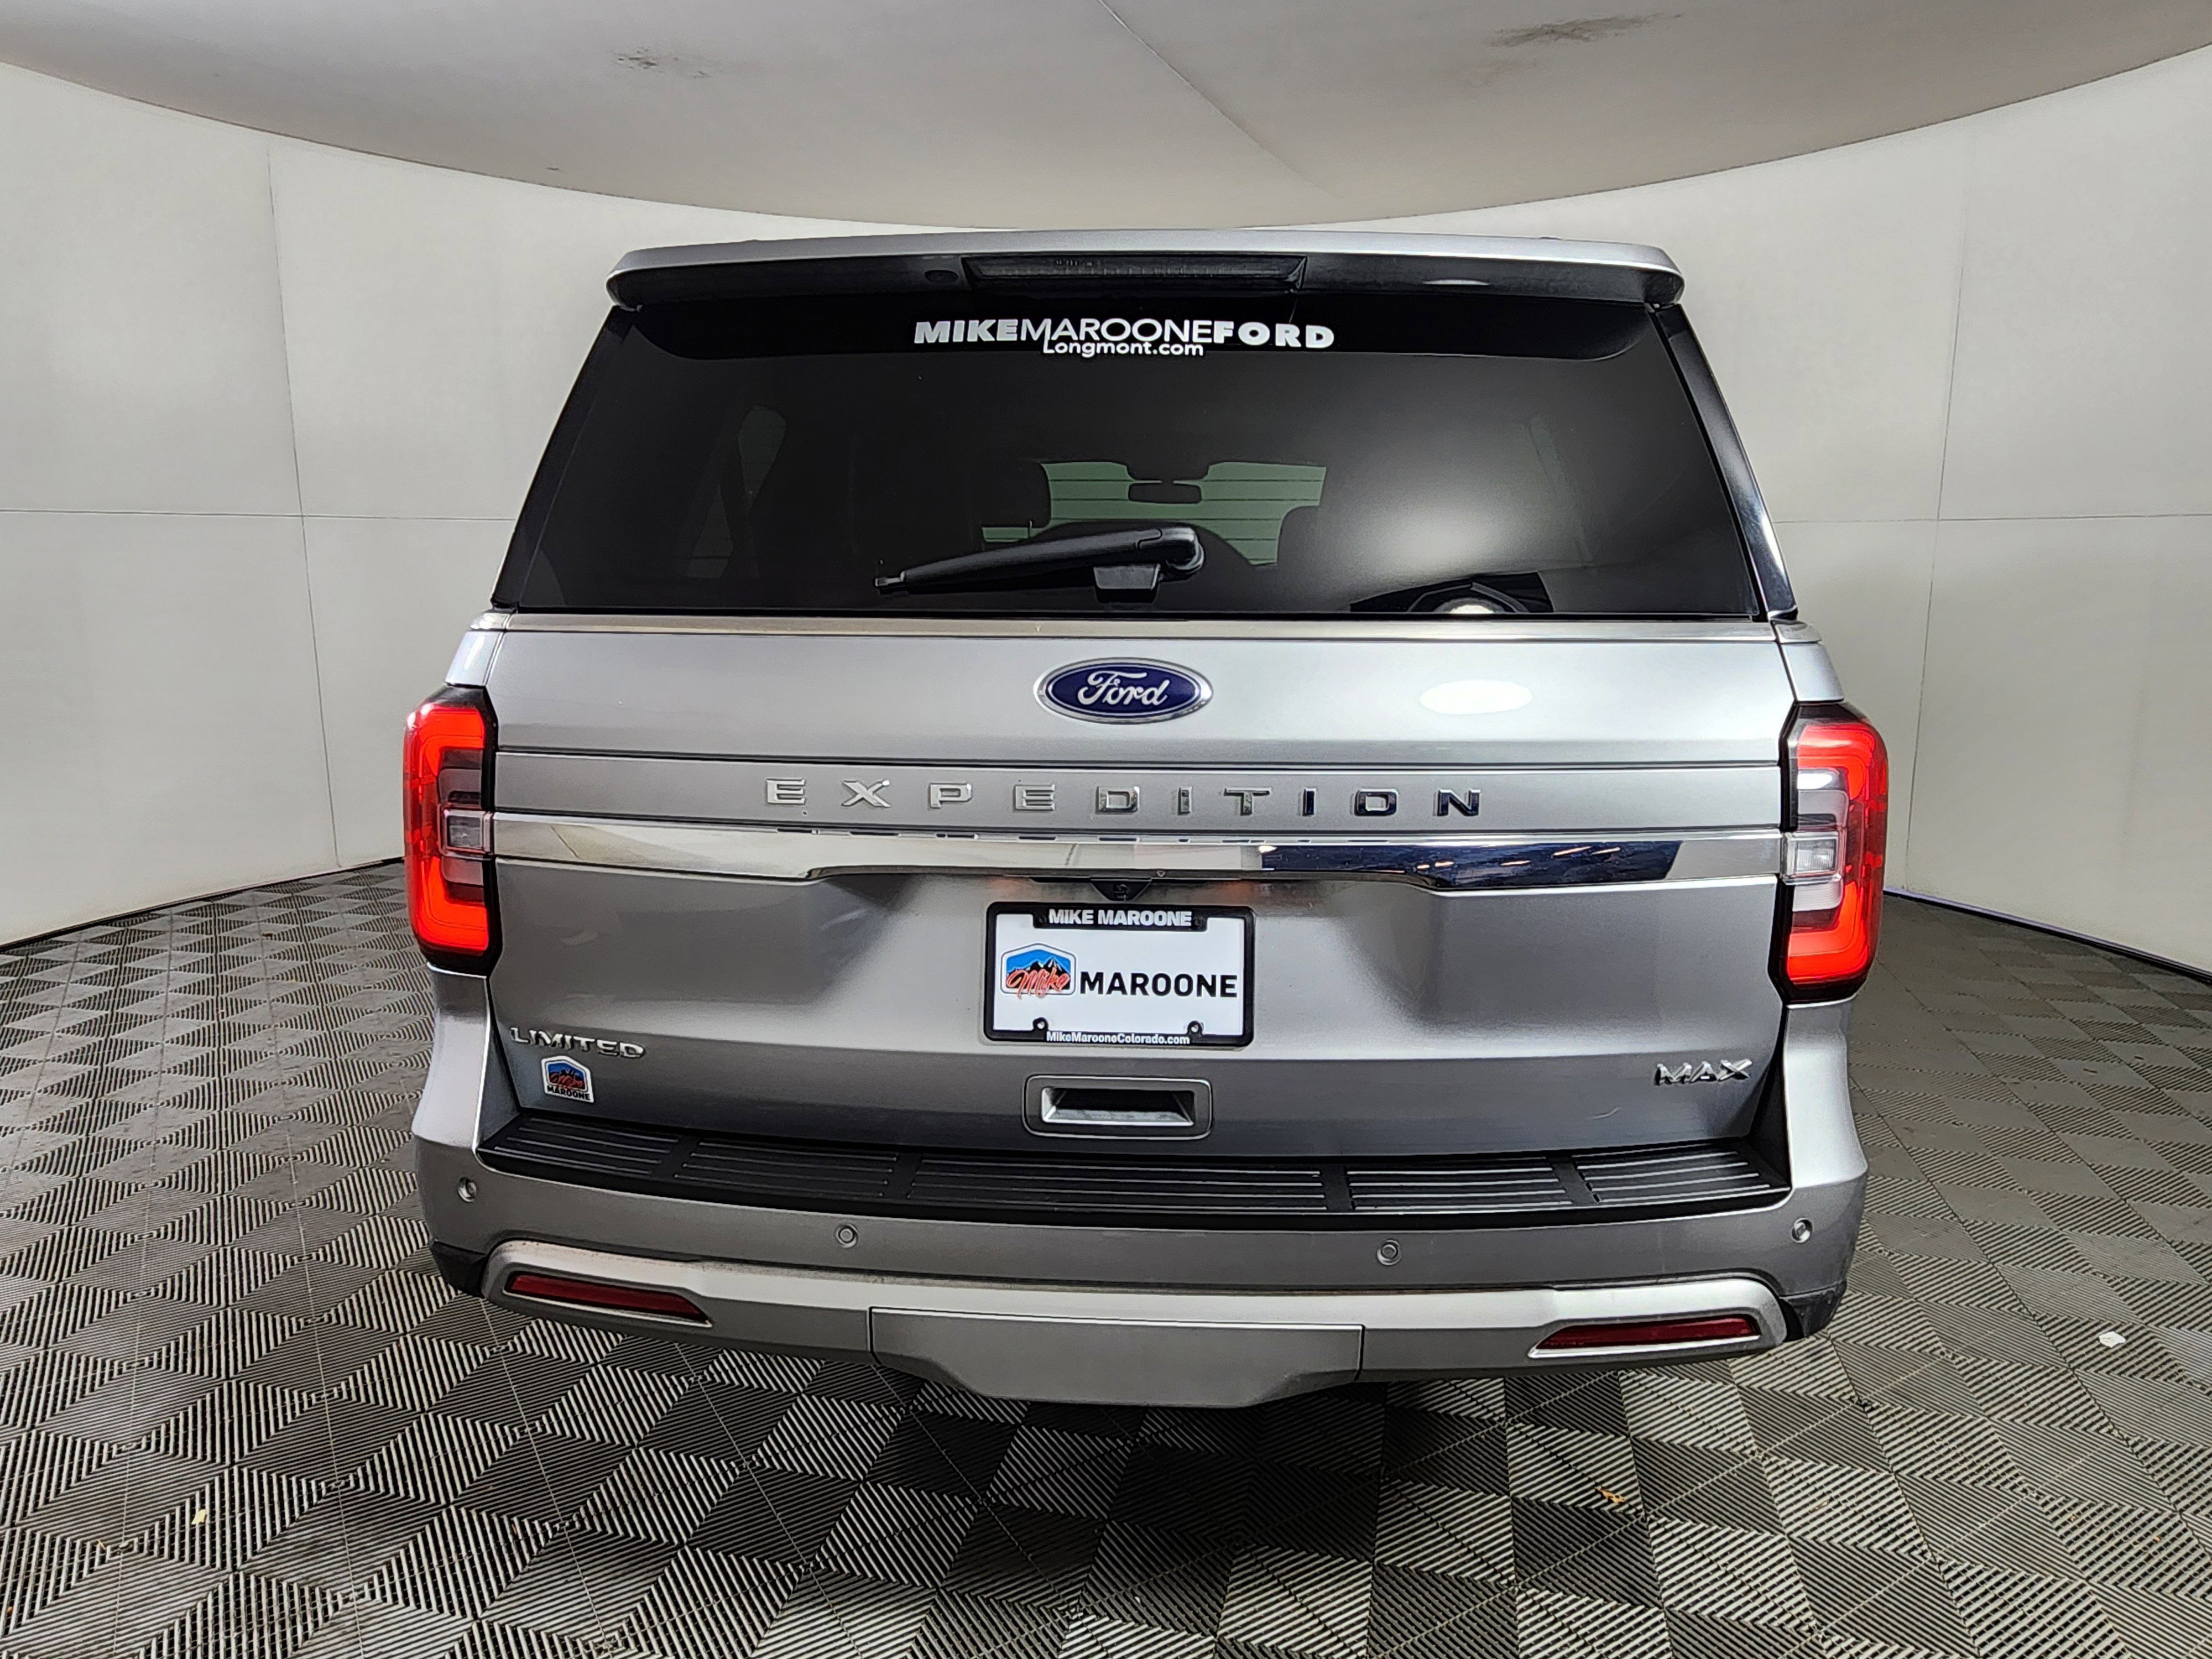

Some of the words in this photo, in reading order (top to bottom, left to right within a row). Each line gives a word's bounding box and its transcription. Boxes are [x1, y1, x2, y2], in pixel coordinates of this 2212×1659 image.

[1043, 338, 1204, 358] Longmont.com
[1078, 670, 1170, 706] Ford
[765, 778, 1481, 817] EXPEDITION
[1049, 909, 1094, 925] MIKE
[1098, 910, 1192, 927] MAROONE
[1006, 967, 1071, 999] Mike
[1080, 972, 1238, 998] MAROONE
[510, 1026, 646, 1058] LIMITED
[1046, 1031, 1190, 1045] MikeMarooneColorado.com
[1654, 1058, 1753, 1086] MAX
[547, 1085, 591, 1100] MAROONE
